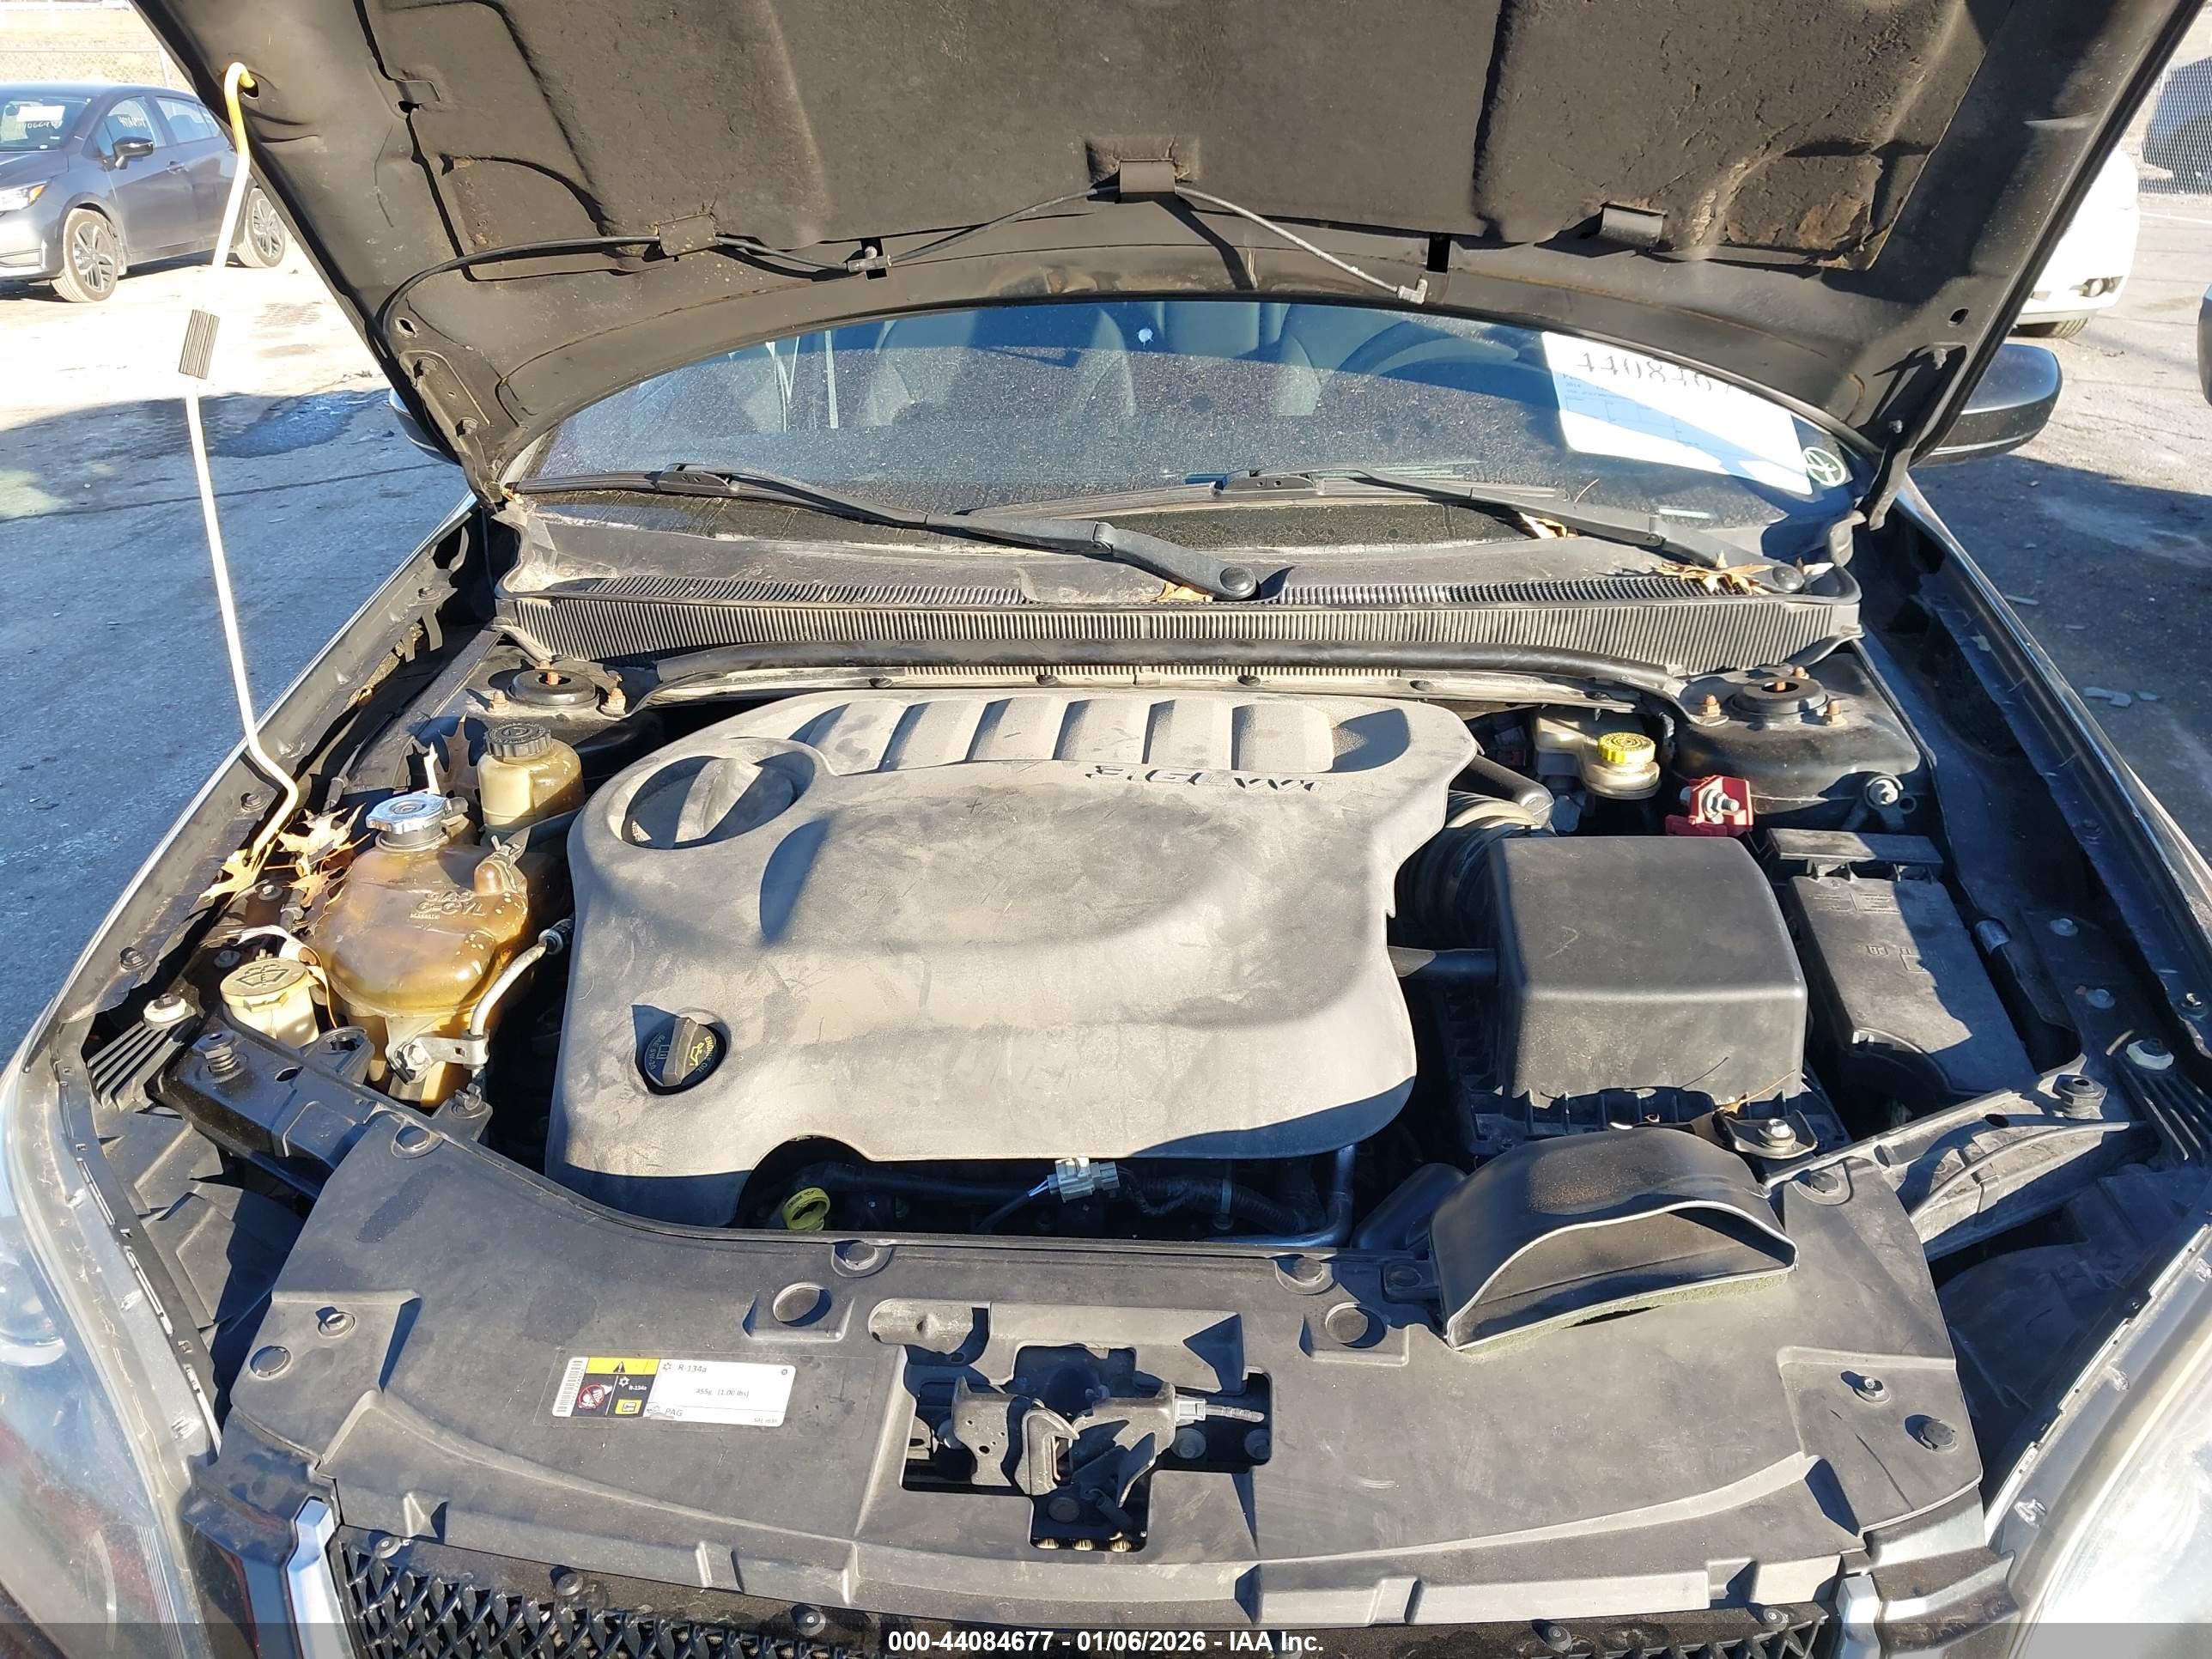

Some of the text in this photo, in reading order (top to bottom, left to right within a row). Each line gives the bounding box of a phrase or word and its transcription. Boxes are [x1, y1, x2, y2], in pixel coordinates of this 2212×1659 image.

[695, 1036, 715, 1073] ENGINE OIL
[677, 1364, 707, 1373] R-134a
[665, 1407, 683, 1417] PAG
